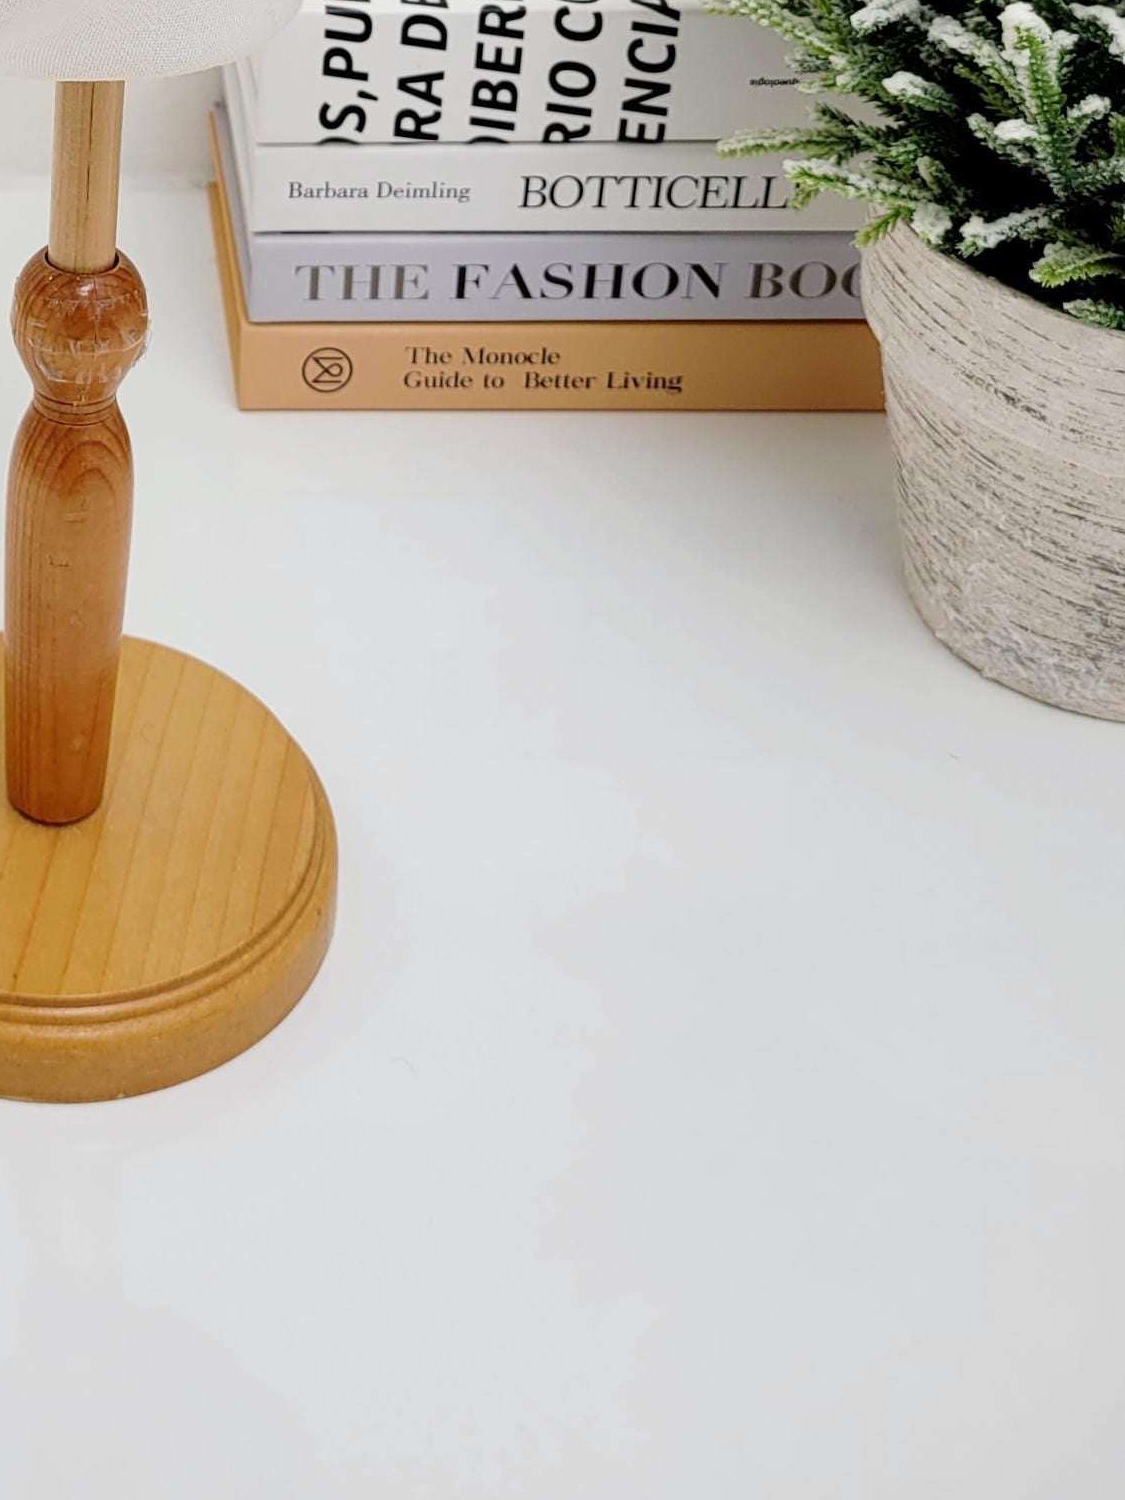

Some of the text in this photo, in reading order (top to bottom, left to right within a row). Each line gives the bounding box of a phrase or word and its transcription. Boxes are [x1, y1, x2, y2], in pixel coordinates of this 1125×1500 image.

[317, 89, 379, 144] S,
[288, 181, 471, 202] Barbara Deimling
[517, 174, 800, 209] BOTTICELL
[295, 263, 428, 301] THE
[405, 347, 562, 365] The Monocle
[403, 370, 684, 393] Guide to Better Living
